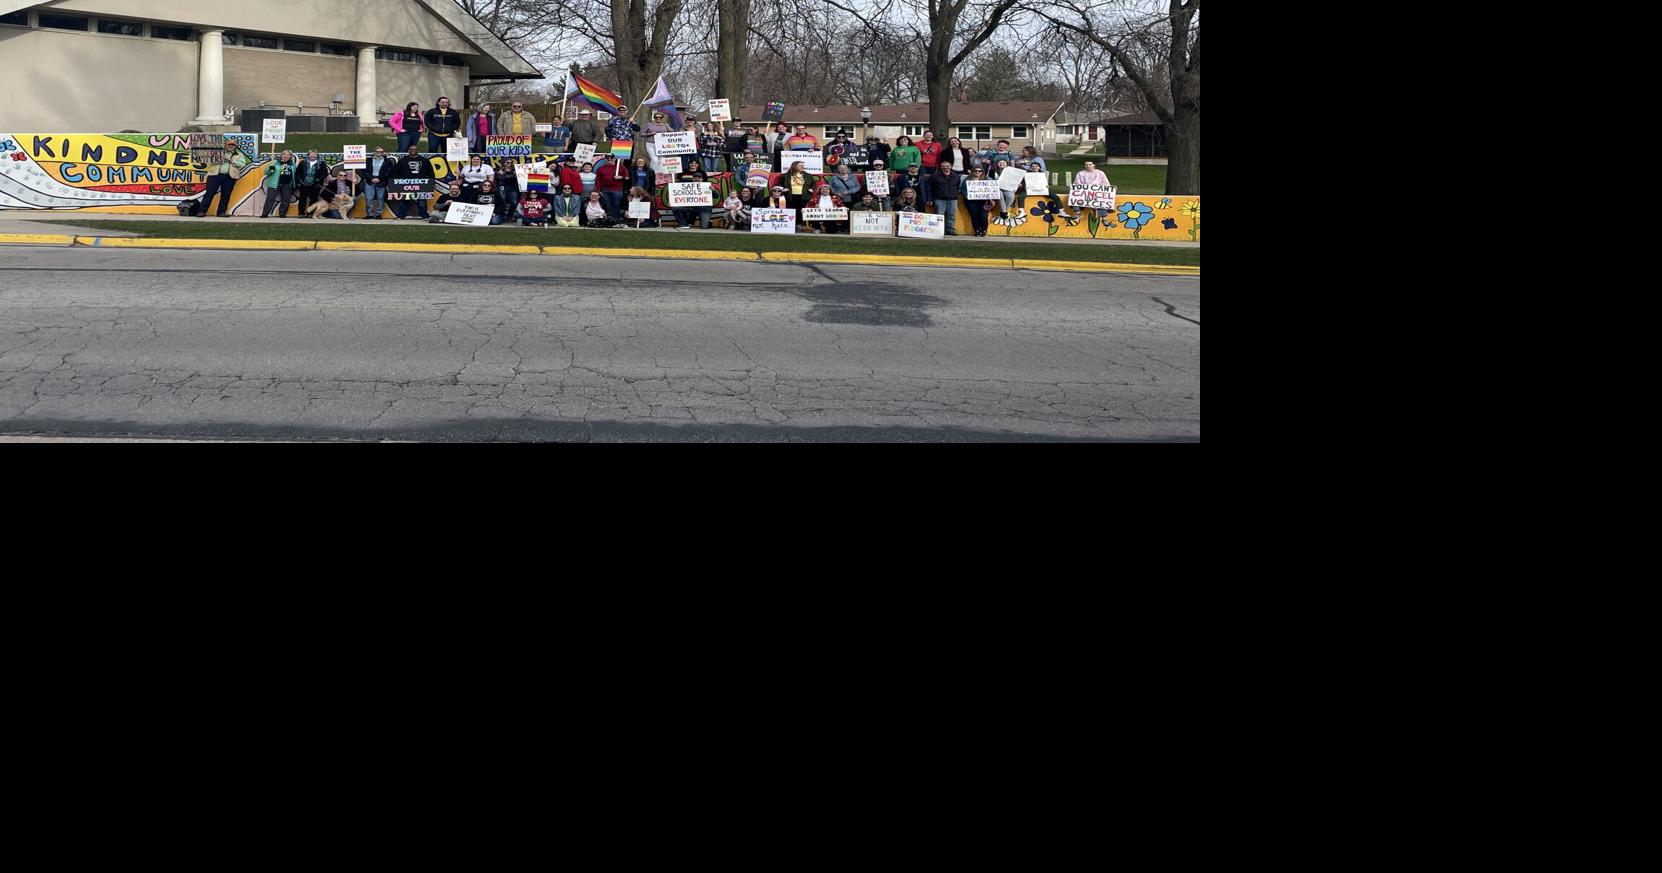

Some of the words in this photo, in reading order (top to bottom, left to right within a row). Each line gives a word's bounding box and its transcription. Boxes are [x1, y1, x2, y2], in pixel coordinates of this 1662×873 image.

[488, 136, 515, 145] PROUD
[516, 135, 530, 145] OF
[487, 146, 506, 156] OUR
[508, 145, 530, 156] KIDS
[150, 185, 197, 194] LOVE
[387, 192, 435, 200] FUTURE
[1072, 191, 1114, 199] CANCEL
[1070, 198, 1112, 209] VOICES
